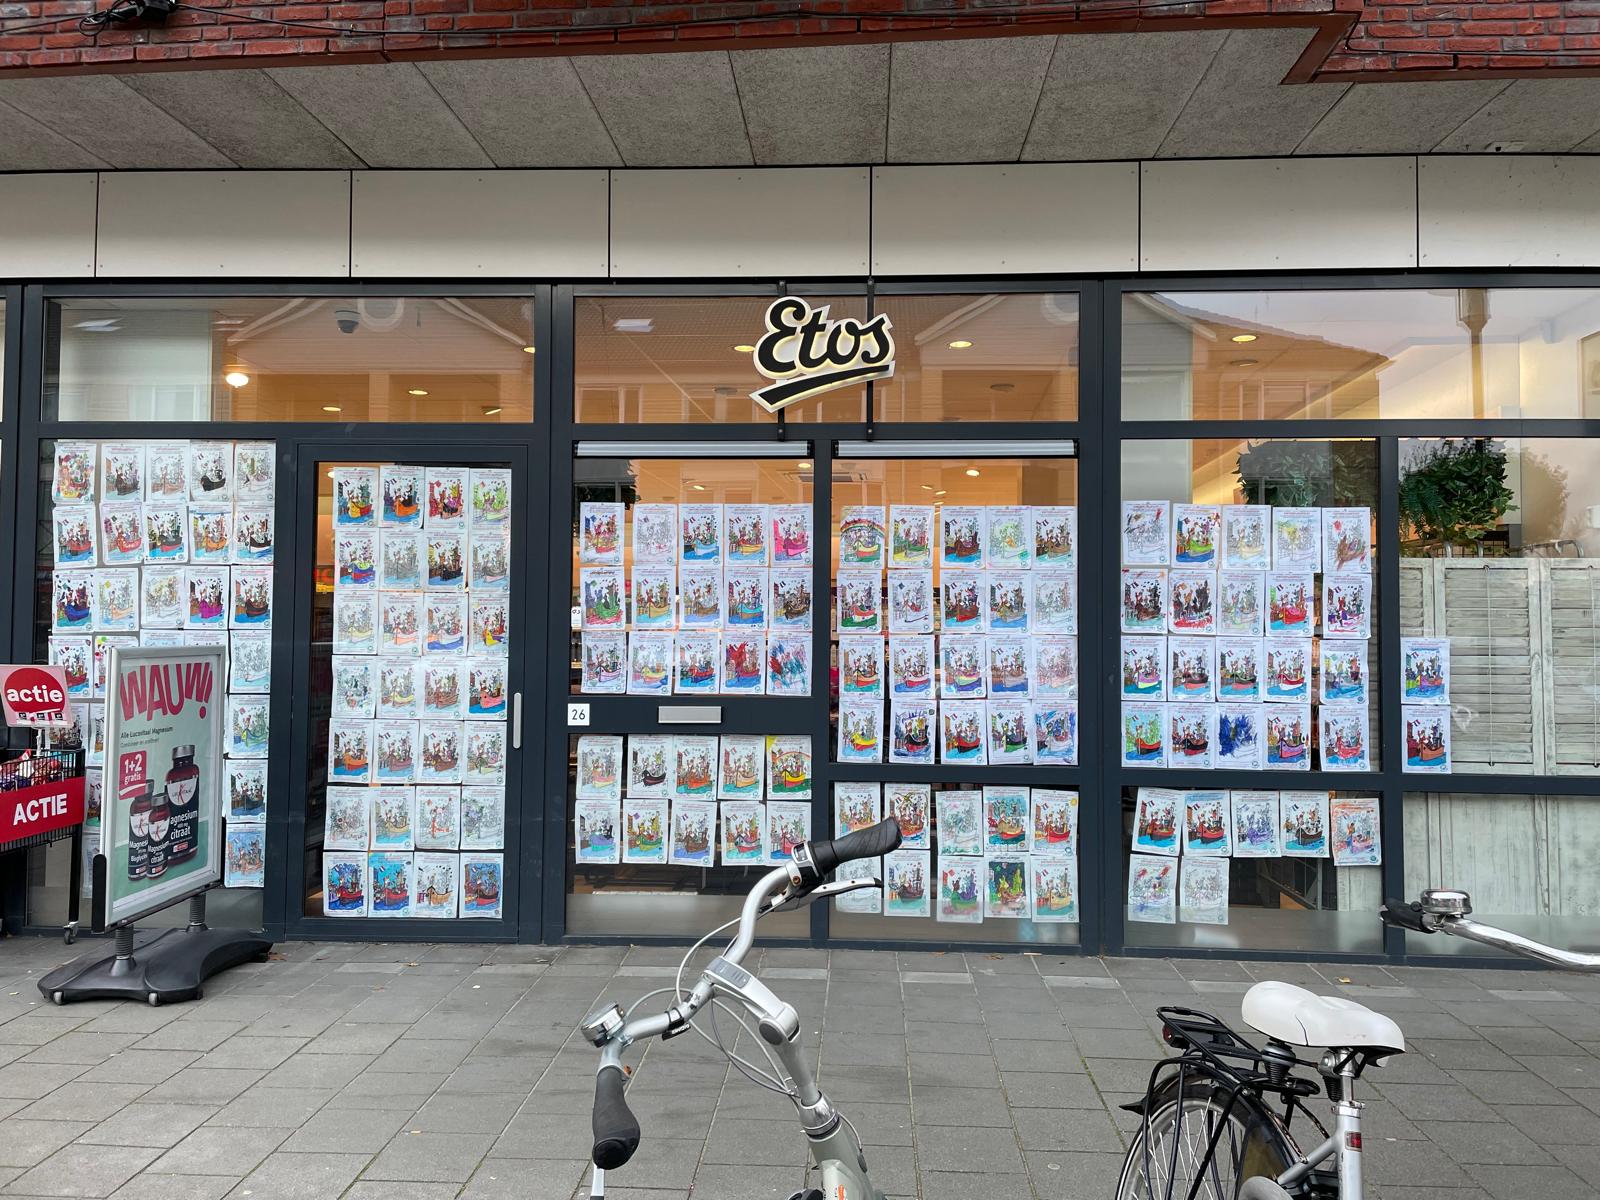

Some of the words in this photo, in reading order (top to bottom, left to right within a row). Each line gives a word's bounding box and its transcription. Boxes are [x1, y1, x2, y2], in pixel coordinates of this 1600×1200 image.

[756, 298, 892, 376] Etos
[6, 684, 63, 703] actie
[120, 662, 213, 721] WAUW!
[572, 708, 586, 720] 26
[124, 753, 143, 774] 1+2
[124, 772, 142, 786] gratis
[13, 793, 68, 826] ACTIE
[170, 810, 198, 826] agnesium
